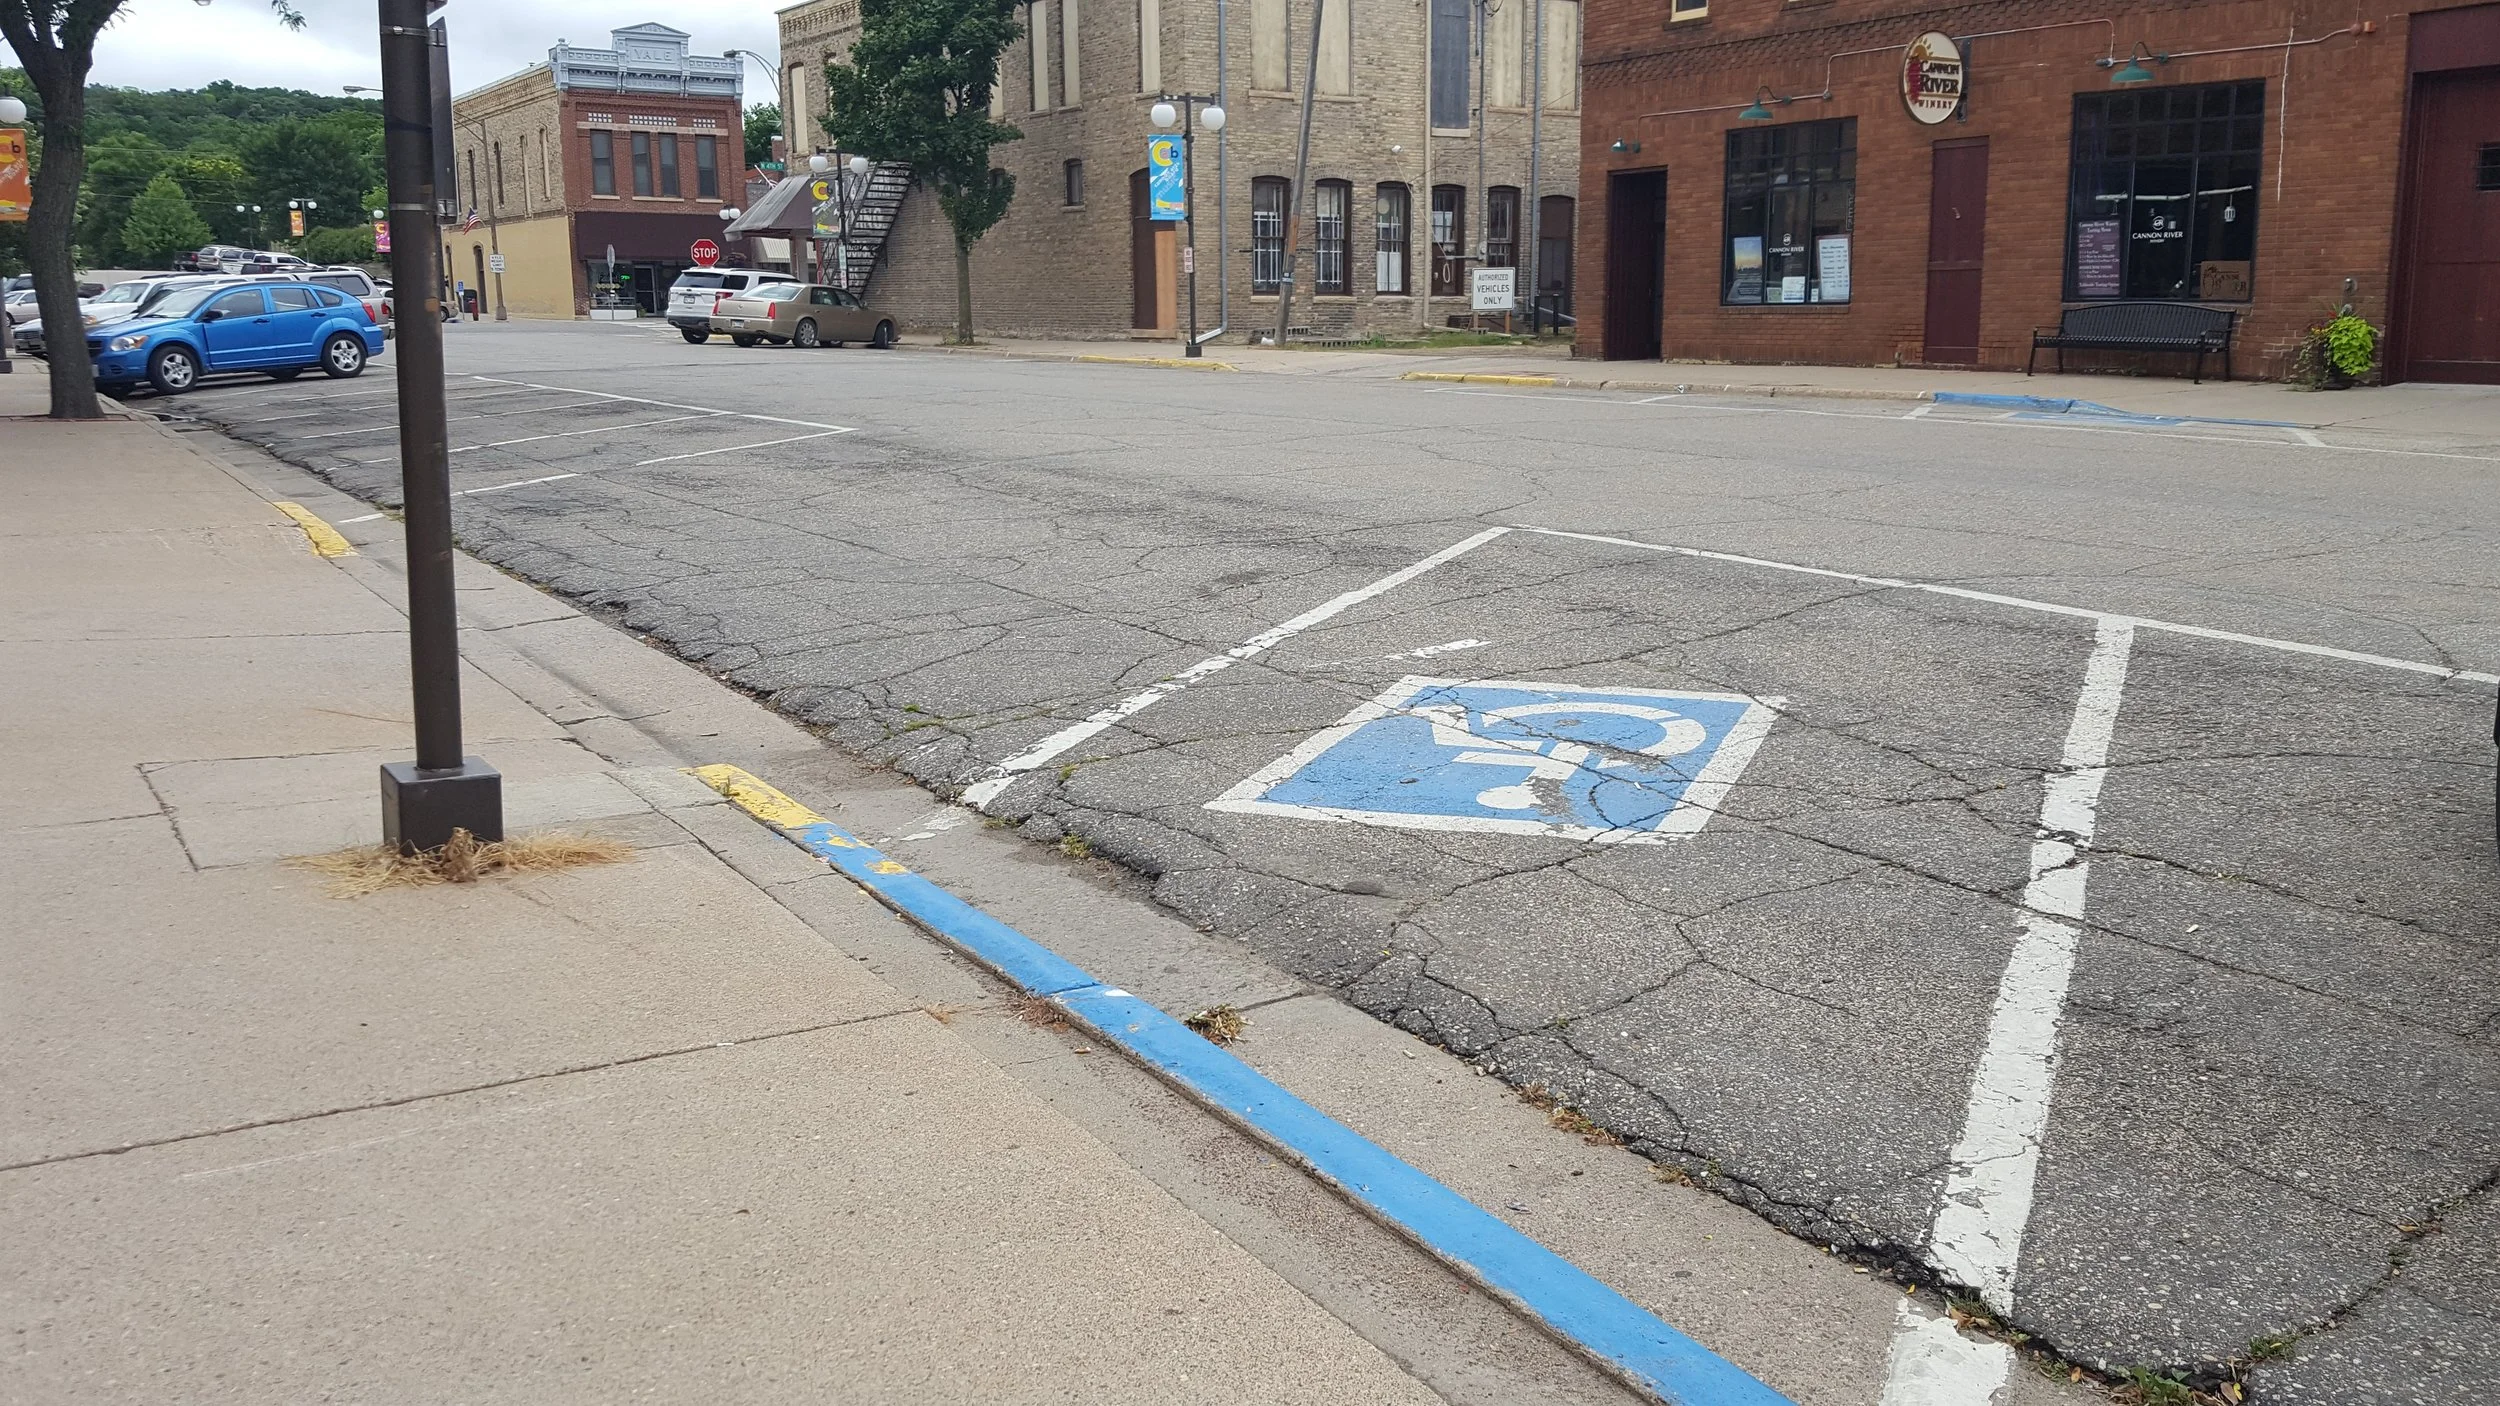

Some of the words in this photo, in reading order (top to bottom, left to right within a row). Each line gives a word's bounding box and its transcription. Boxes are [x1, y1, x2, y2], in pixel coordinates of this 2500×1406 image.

[1920, 60, 1960, 75] CANNON
[1919, 74, 1960, 94] RIVER
[1918, 100, 1953, 109] WINERY
[693, 247, 717, 258] STOP
[1477, 284, 1510, 293] VEHICLES
[1483, 296, 1503, 305] ONLY
